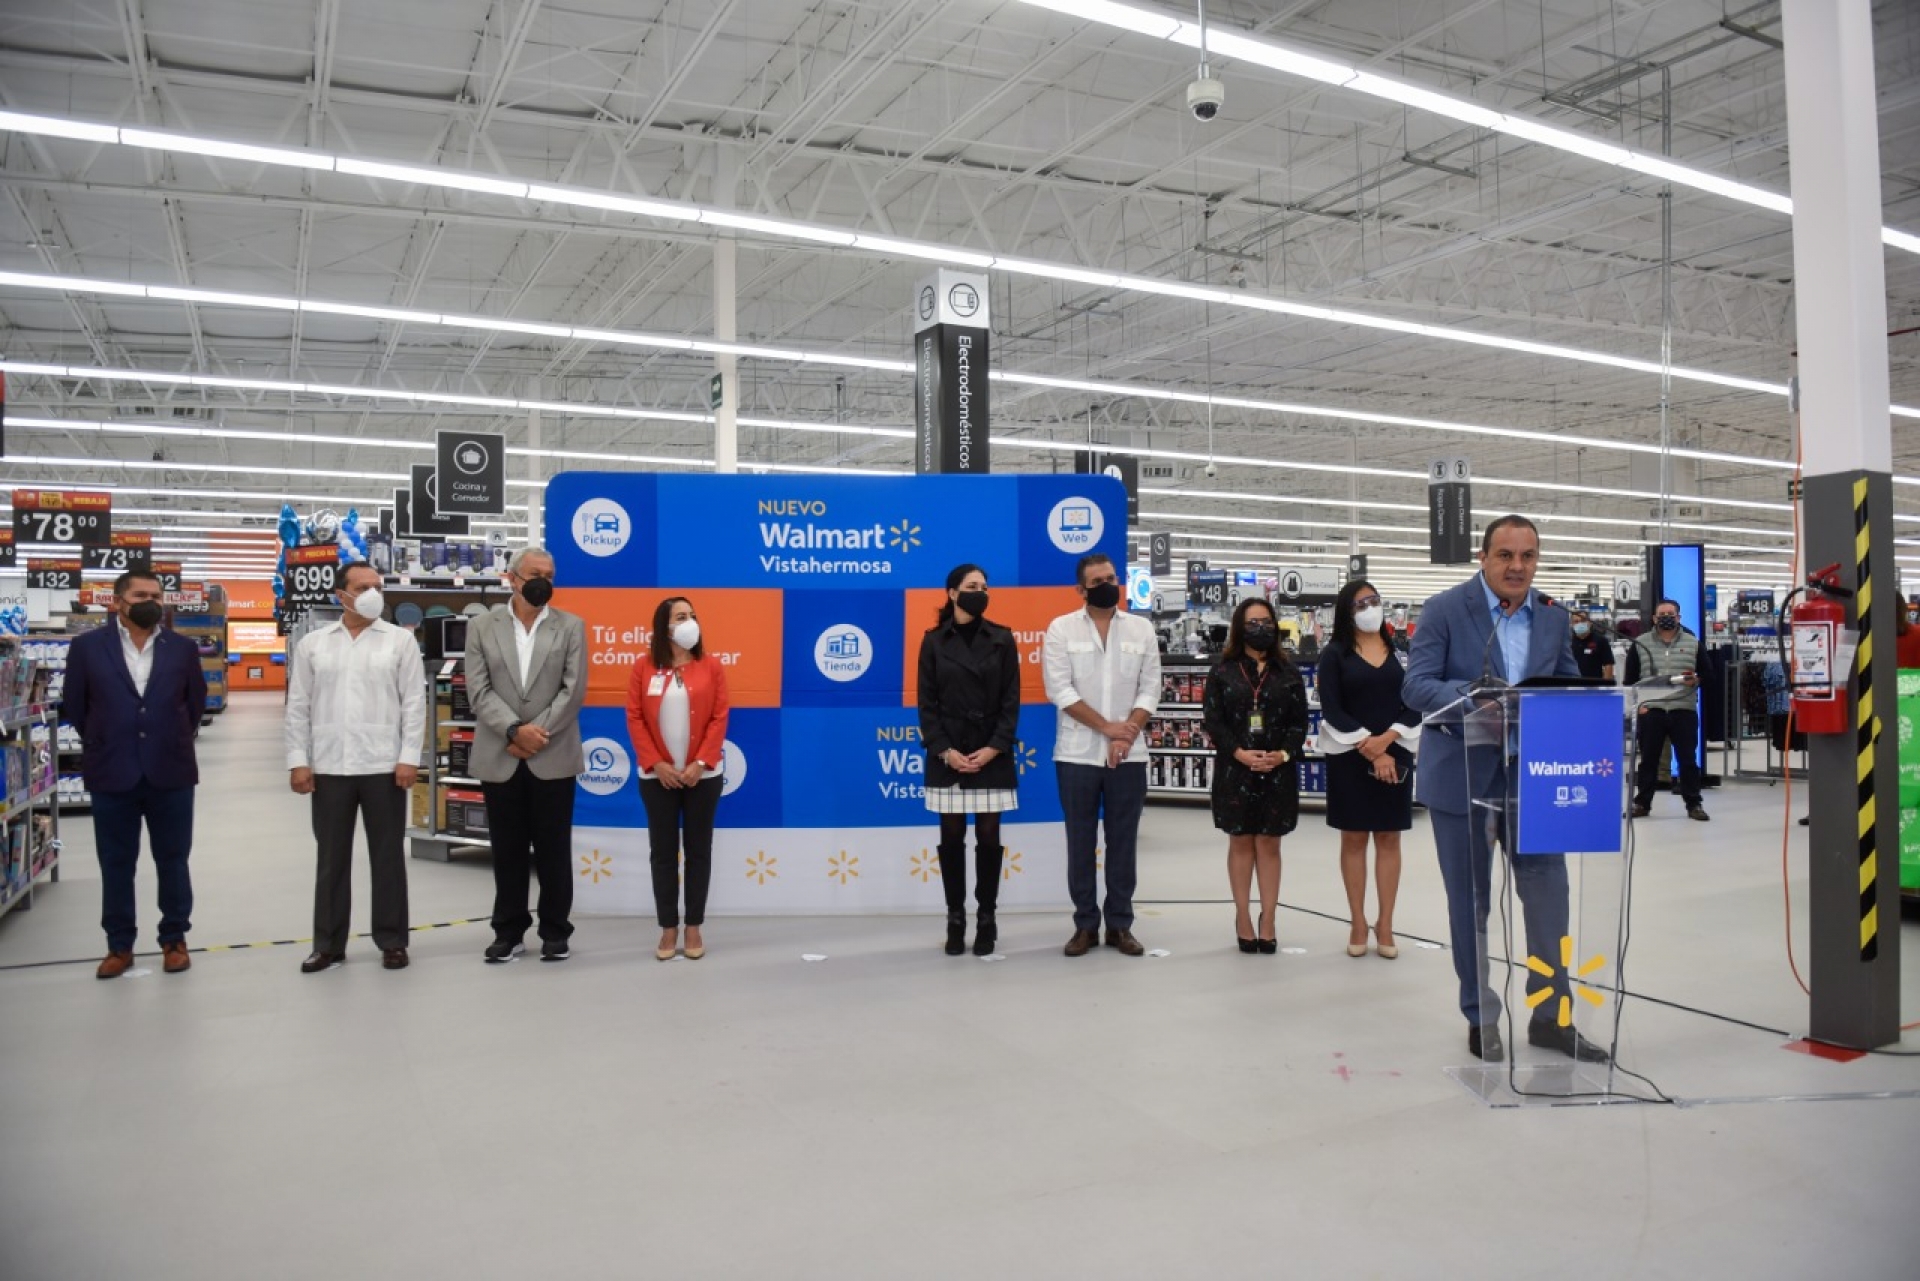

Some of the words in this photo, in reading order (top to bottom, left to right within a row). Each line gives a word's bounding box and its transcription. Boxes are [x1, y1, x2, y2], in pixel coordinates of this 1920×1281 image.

[958, 335, 973, 469] Electrodomésticos
[453, 482, 481, 491] Cocina
[482, 484, 487, 492] y
[452, 493, 490, 502] Comedor
[758, 500, 827, 516] NUEVO
[583, 535, 621, 547] Pickup
[759, 523, 886, 549] Walmart
[1062, 534, 1088, 543] Web
[759, 555, 892, 573] Vistahermosa
[592, 625, 616, 644] Tú
[823, 661, 862, 671] Tienda
[1528, 761, 1595, 776] Walmart
[579, 774, 624, 785] WhatsApp
